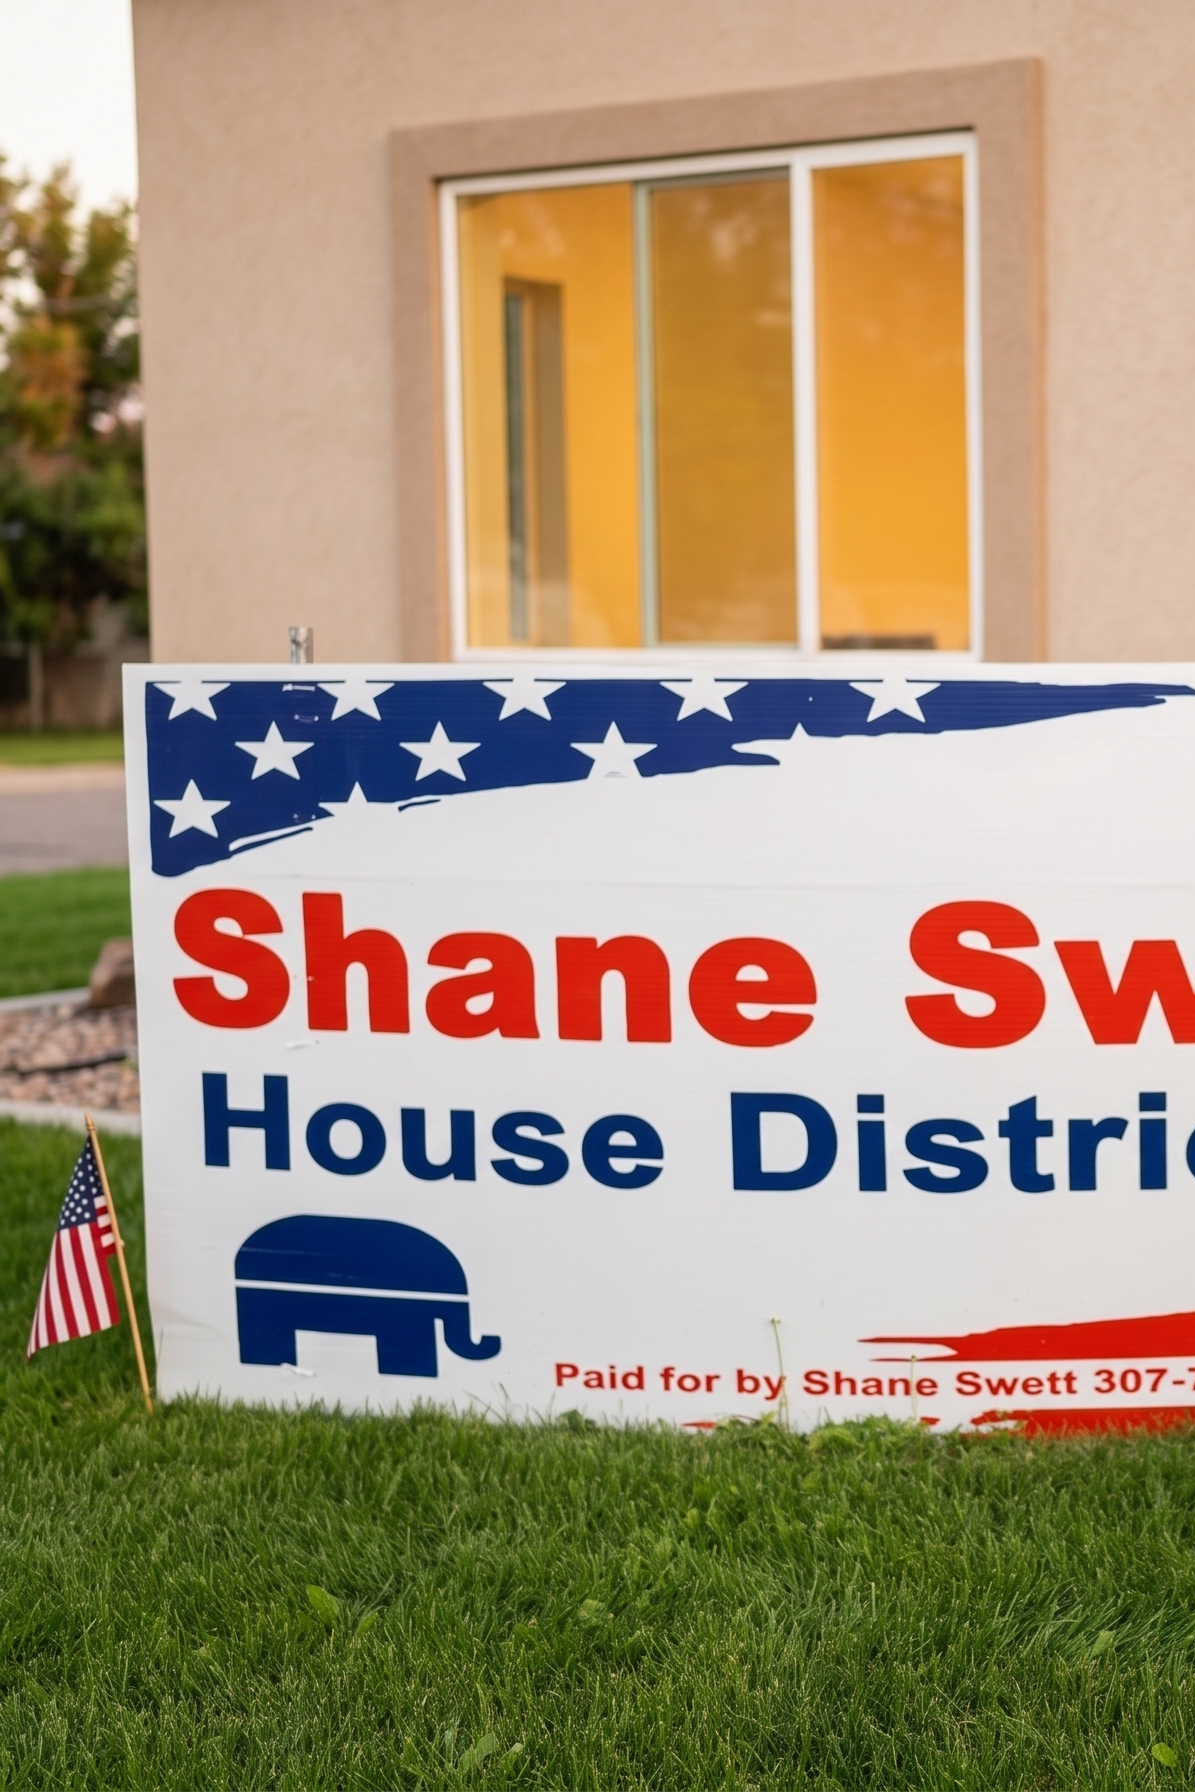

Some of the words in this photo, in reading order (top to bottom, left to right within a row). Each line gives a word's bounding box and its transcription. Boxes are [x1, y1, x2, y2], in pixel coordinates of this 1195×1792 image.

[172, 887, 818, 1049] Shane
[202, 1073, 664, 1190] House
[554, 1362, 646, 1391] Paid
[659, 1365, 721, 1394] for
[735, 1368, 784, 1402] by
[802, 1368, 940, 1398] Shane
[954, 1367, 1078, 1398] Swett
